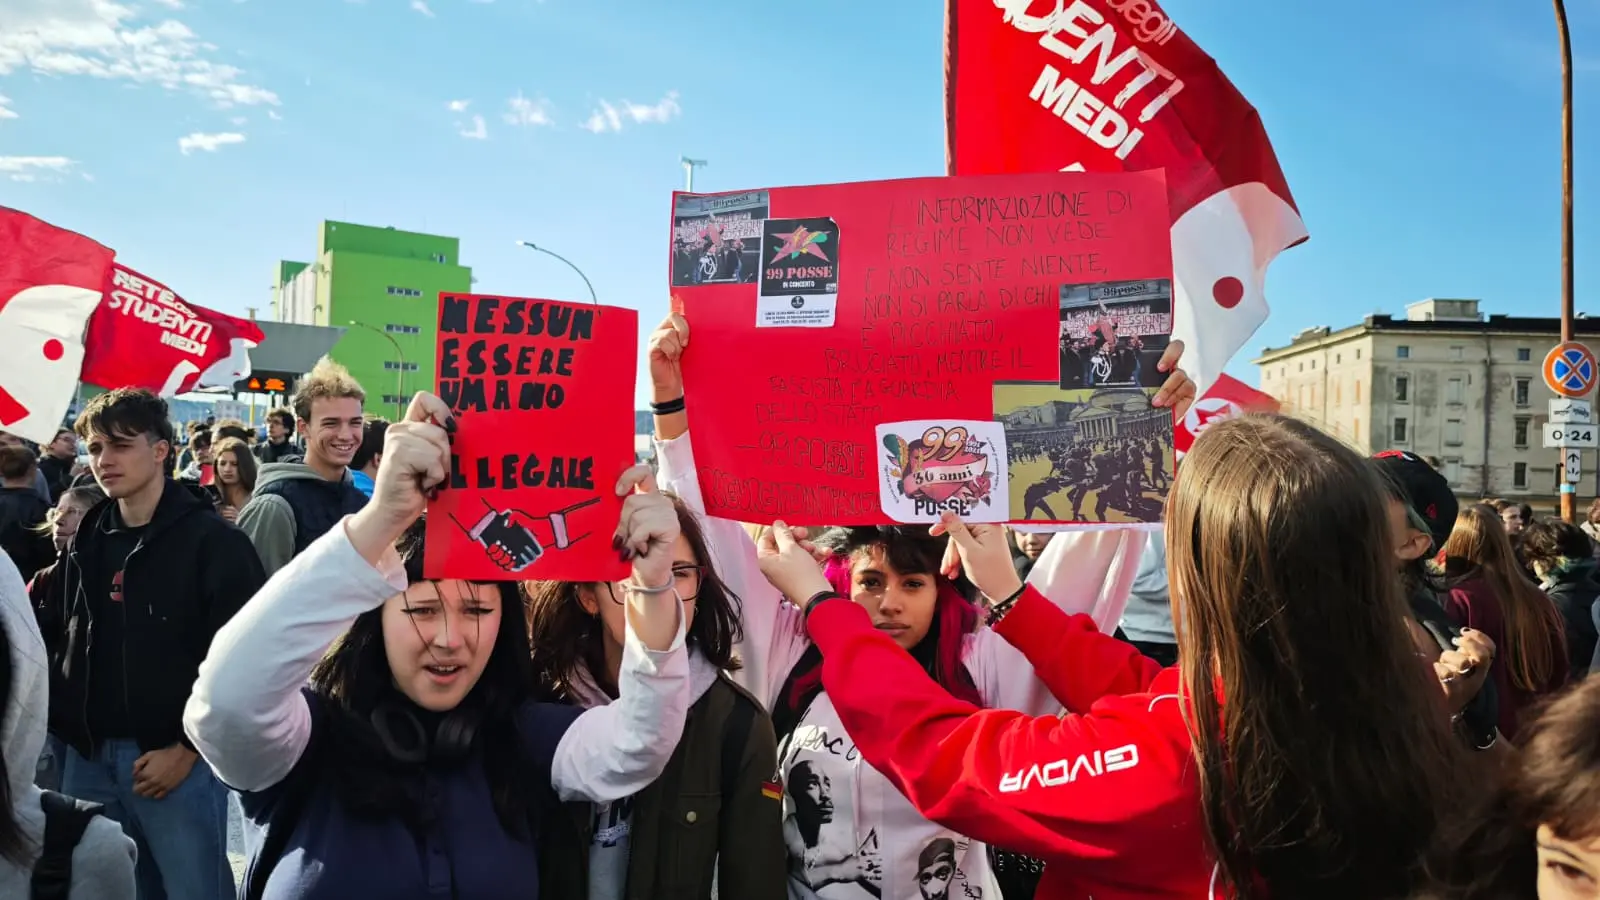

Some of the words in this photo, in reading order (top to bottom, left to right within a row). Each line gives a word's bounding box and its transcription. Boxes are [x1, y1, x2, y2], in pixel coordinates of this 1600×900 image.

[993, 0, 1184, 123] DENTI
[1029, 64, 1144, 160] MEDI
[1106, 189, 1133, 215] DI
[886, 226, 971, 259] REGIME
[986, 222, 1033, 249] NON
[1046, 221, 1112, 244] VEDE
[112, 268, 176, 307] RETE
[766, 268, 784, 280] 99
[786, 266, 833, 279] POSSE
[888, 265, 930, 292] NON
[940, 258, 1007, 285] SENTE
[1021, 252, 1108, 278] NIENTE,
[108, 289, 213, 343] STUDENTI
[440, 296, 594, 341] NESSUN
[863, 293, 902, 321] NON
[909, 293, 927, 317] SI
[937, 289, 991, 313] PARLA
[999, 286, 1018, 310] DI
[1023, 283, 1052, 308] CHI
[160, 331, 207, 357] MEDI
[441, 338, 575, 379] ESSERE
[937, 349, 1004, 375] MENTRE
[1010, 346, 1032, 368] IL
[439, 377, 565, 413] UMANO
[755, 400, 818, 424] DELLO
[922, 426, 968, 461] 99
[1552, 430, 1592, 441] 0-24
[450, 453, 595, 490] LLEGALE
[939, 465, 973, 480] anni
[915, 499, 971, 516] POSSE
[999, 743, 1139, 793] GIVOVA
